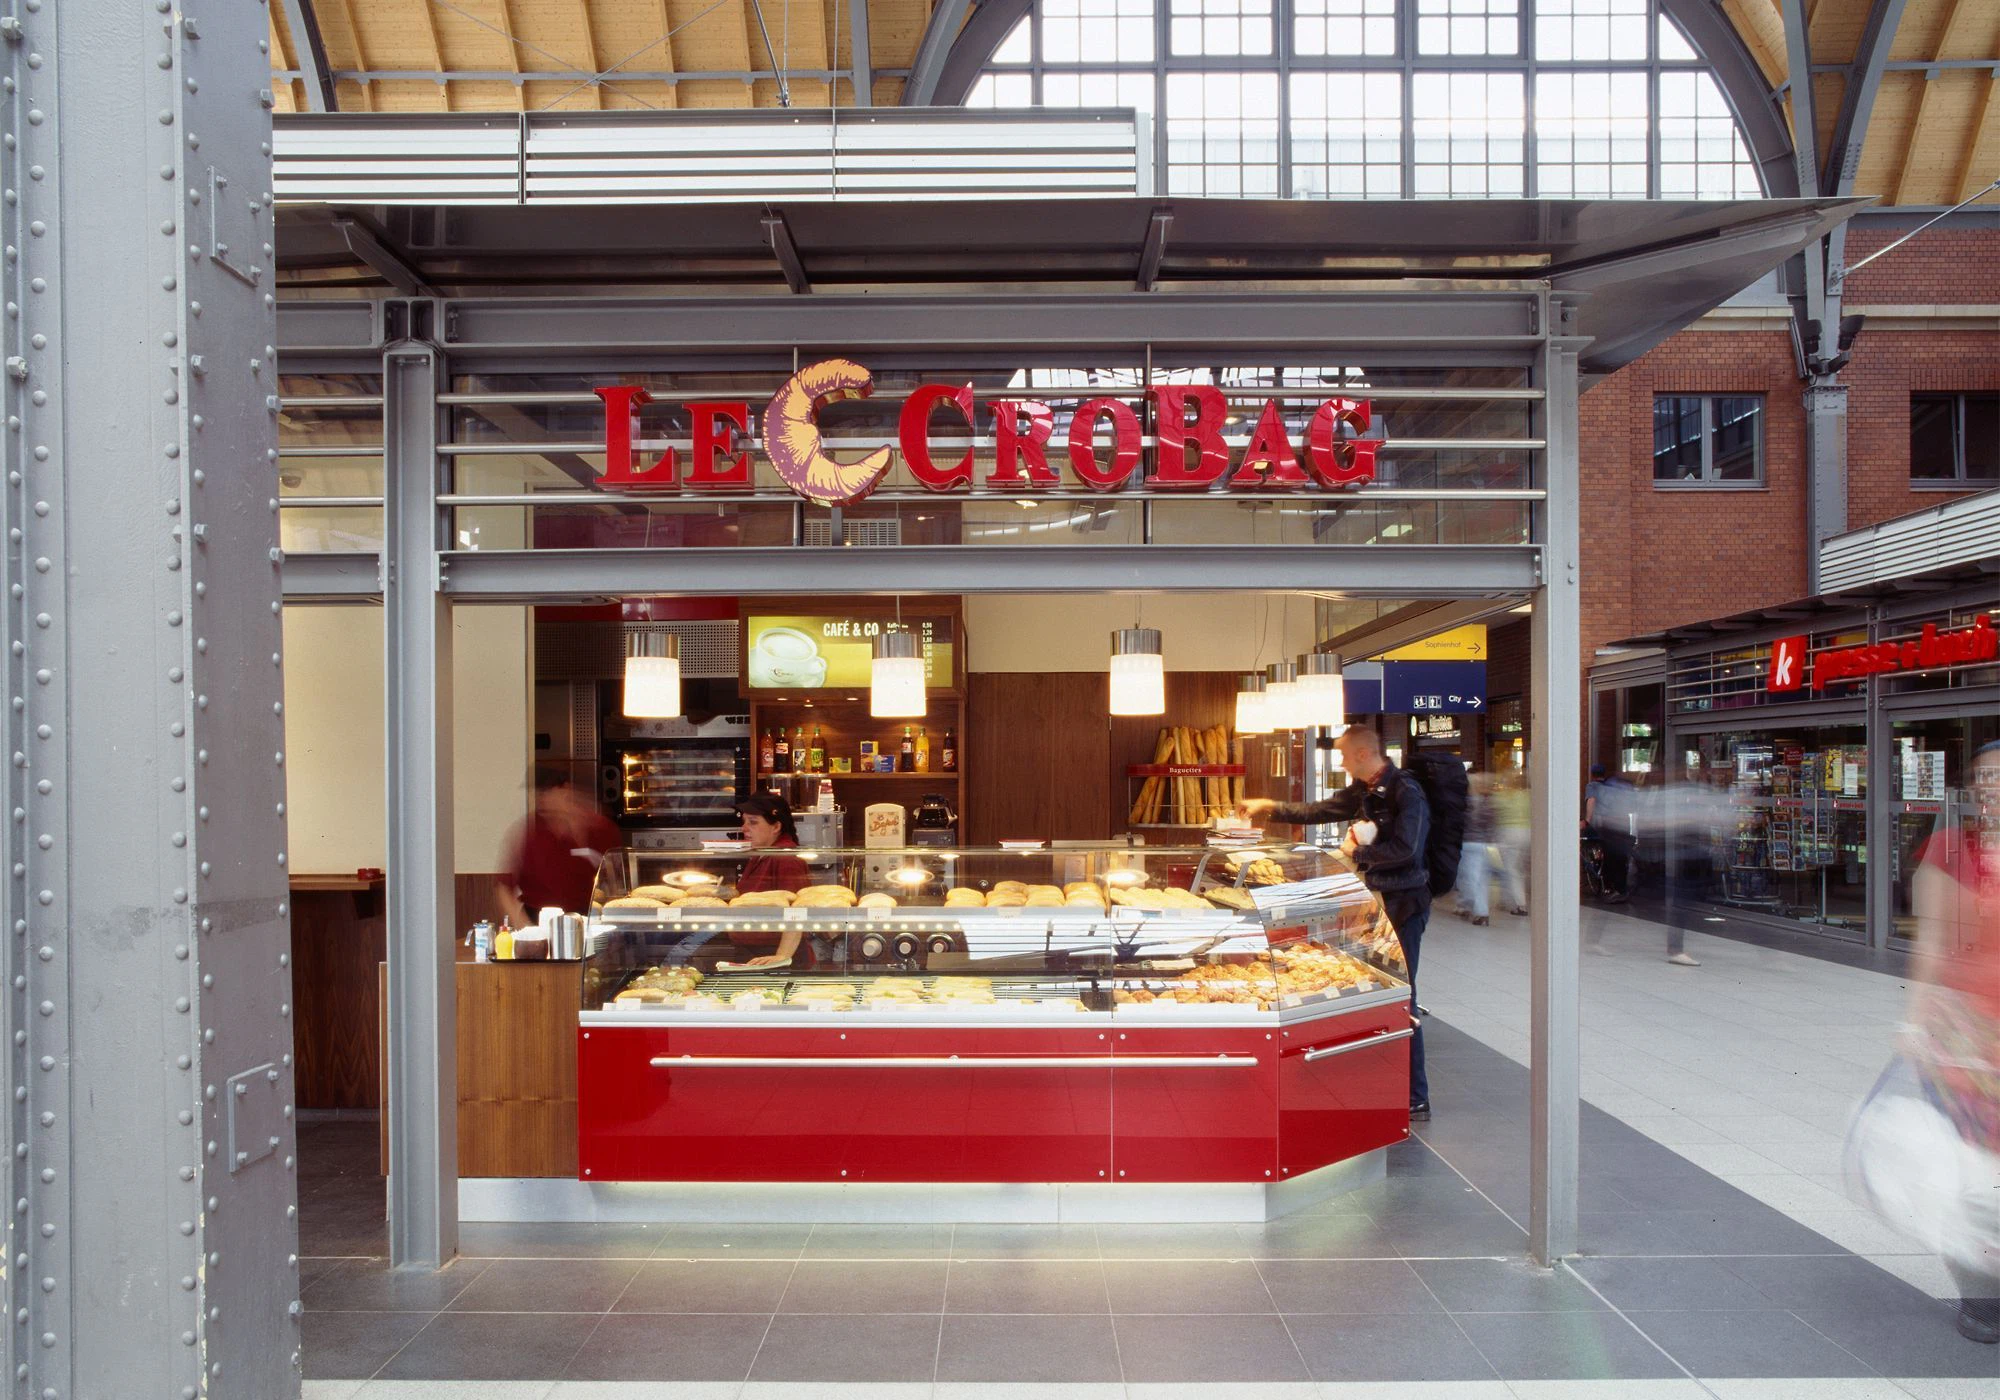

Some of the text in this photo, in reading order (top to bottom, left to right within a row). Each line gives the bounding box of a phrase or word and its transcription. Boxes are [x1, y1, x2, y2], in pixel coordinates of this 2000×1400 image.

[593, 384, 756, 493] LE
[823, 620, 849, 637] CAFÉ
[852, 622, 861, 637] &
[1776, 642, 1793, 686] k
[1448, 695, 1462, 704] City
